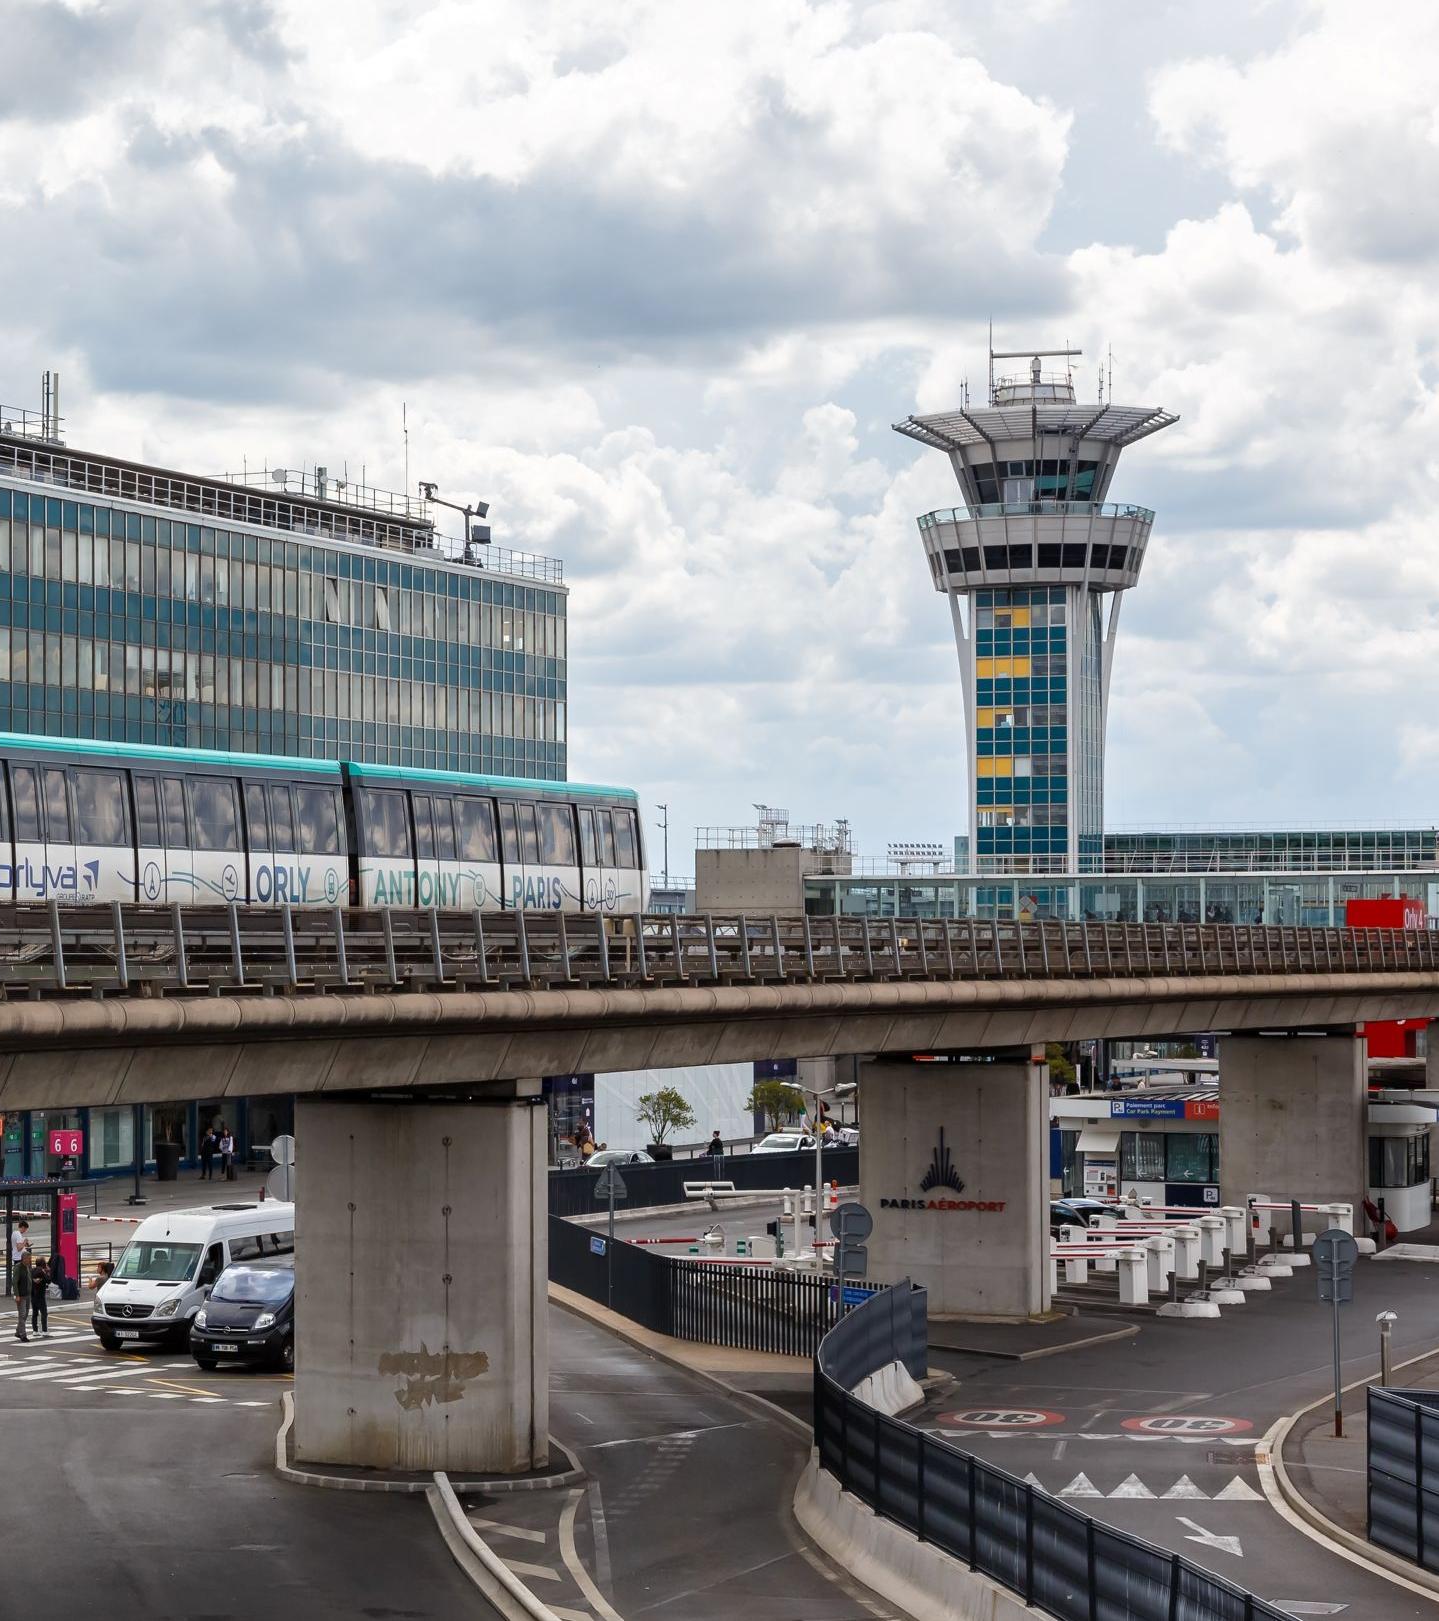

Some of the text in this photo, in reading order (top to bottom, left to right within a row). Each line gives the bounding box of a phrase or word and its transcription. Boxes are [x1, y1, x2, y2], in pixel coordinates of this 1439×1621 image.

[256, 865, 310, 903] ORLY
[373, 869, 460, 907] ANTONY
[512, 875, 561, 909] PARIS
[54, 1138, 62, 1152] 6
[70, 1138, 78, 1152] 6
[880, 1197, 1006, 1212] PARIS AÉROPORT
